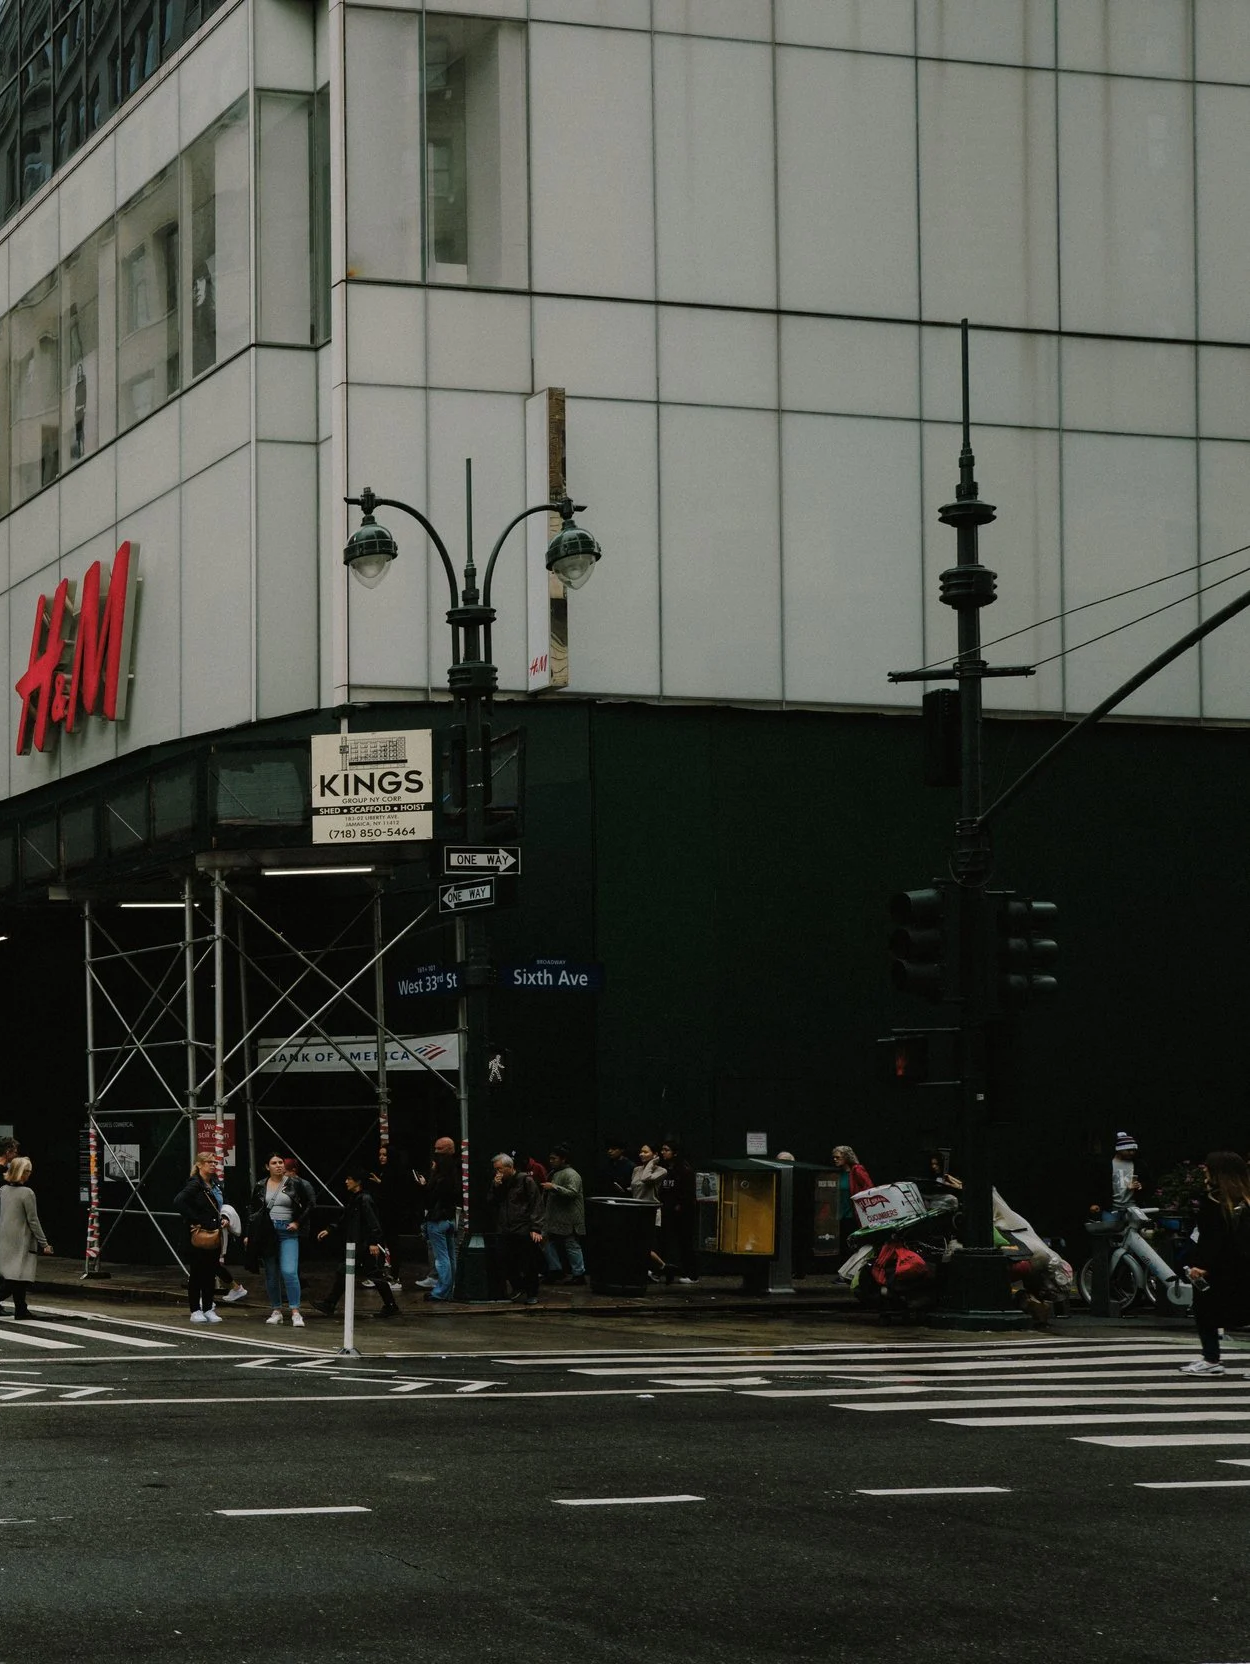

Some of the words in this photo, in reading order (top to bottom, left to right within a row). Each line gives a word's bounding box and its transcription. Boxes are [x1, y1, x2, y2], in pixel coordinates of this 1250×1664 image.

[15, 540, 132, 756] H&M
[319, 770, 424, 797] KINGS
[350, 805, 391, 813] SCAFFOLD
[400, 803, 425, 811] HOIST
[328, 829, 356, 839] (718)
[359, 827, 416, 838] 850-5464
[457, 855, 477, 865] ONE
[486, 855, 509, 866] WAY
[447, 892, 462, 903] ONE
[469, 887, 486, 899] WAY
[397, 978, 424, 996] West
[425, 972, 444, 992] 33rd
[446, 972, 458, 989] St
[513, 968, 553, 986] Sixth
[558, 970, 589, 987] Ave
[269, 1052, 310, 1063] BANK
[314, 1052, 334, 1062] OF
[198, 1131, 210, 1139] still
[866, 1208, 899, 1222] CUCUMBERS
